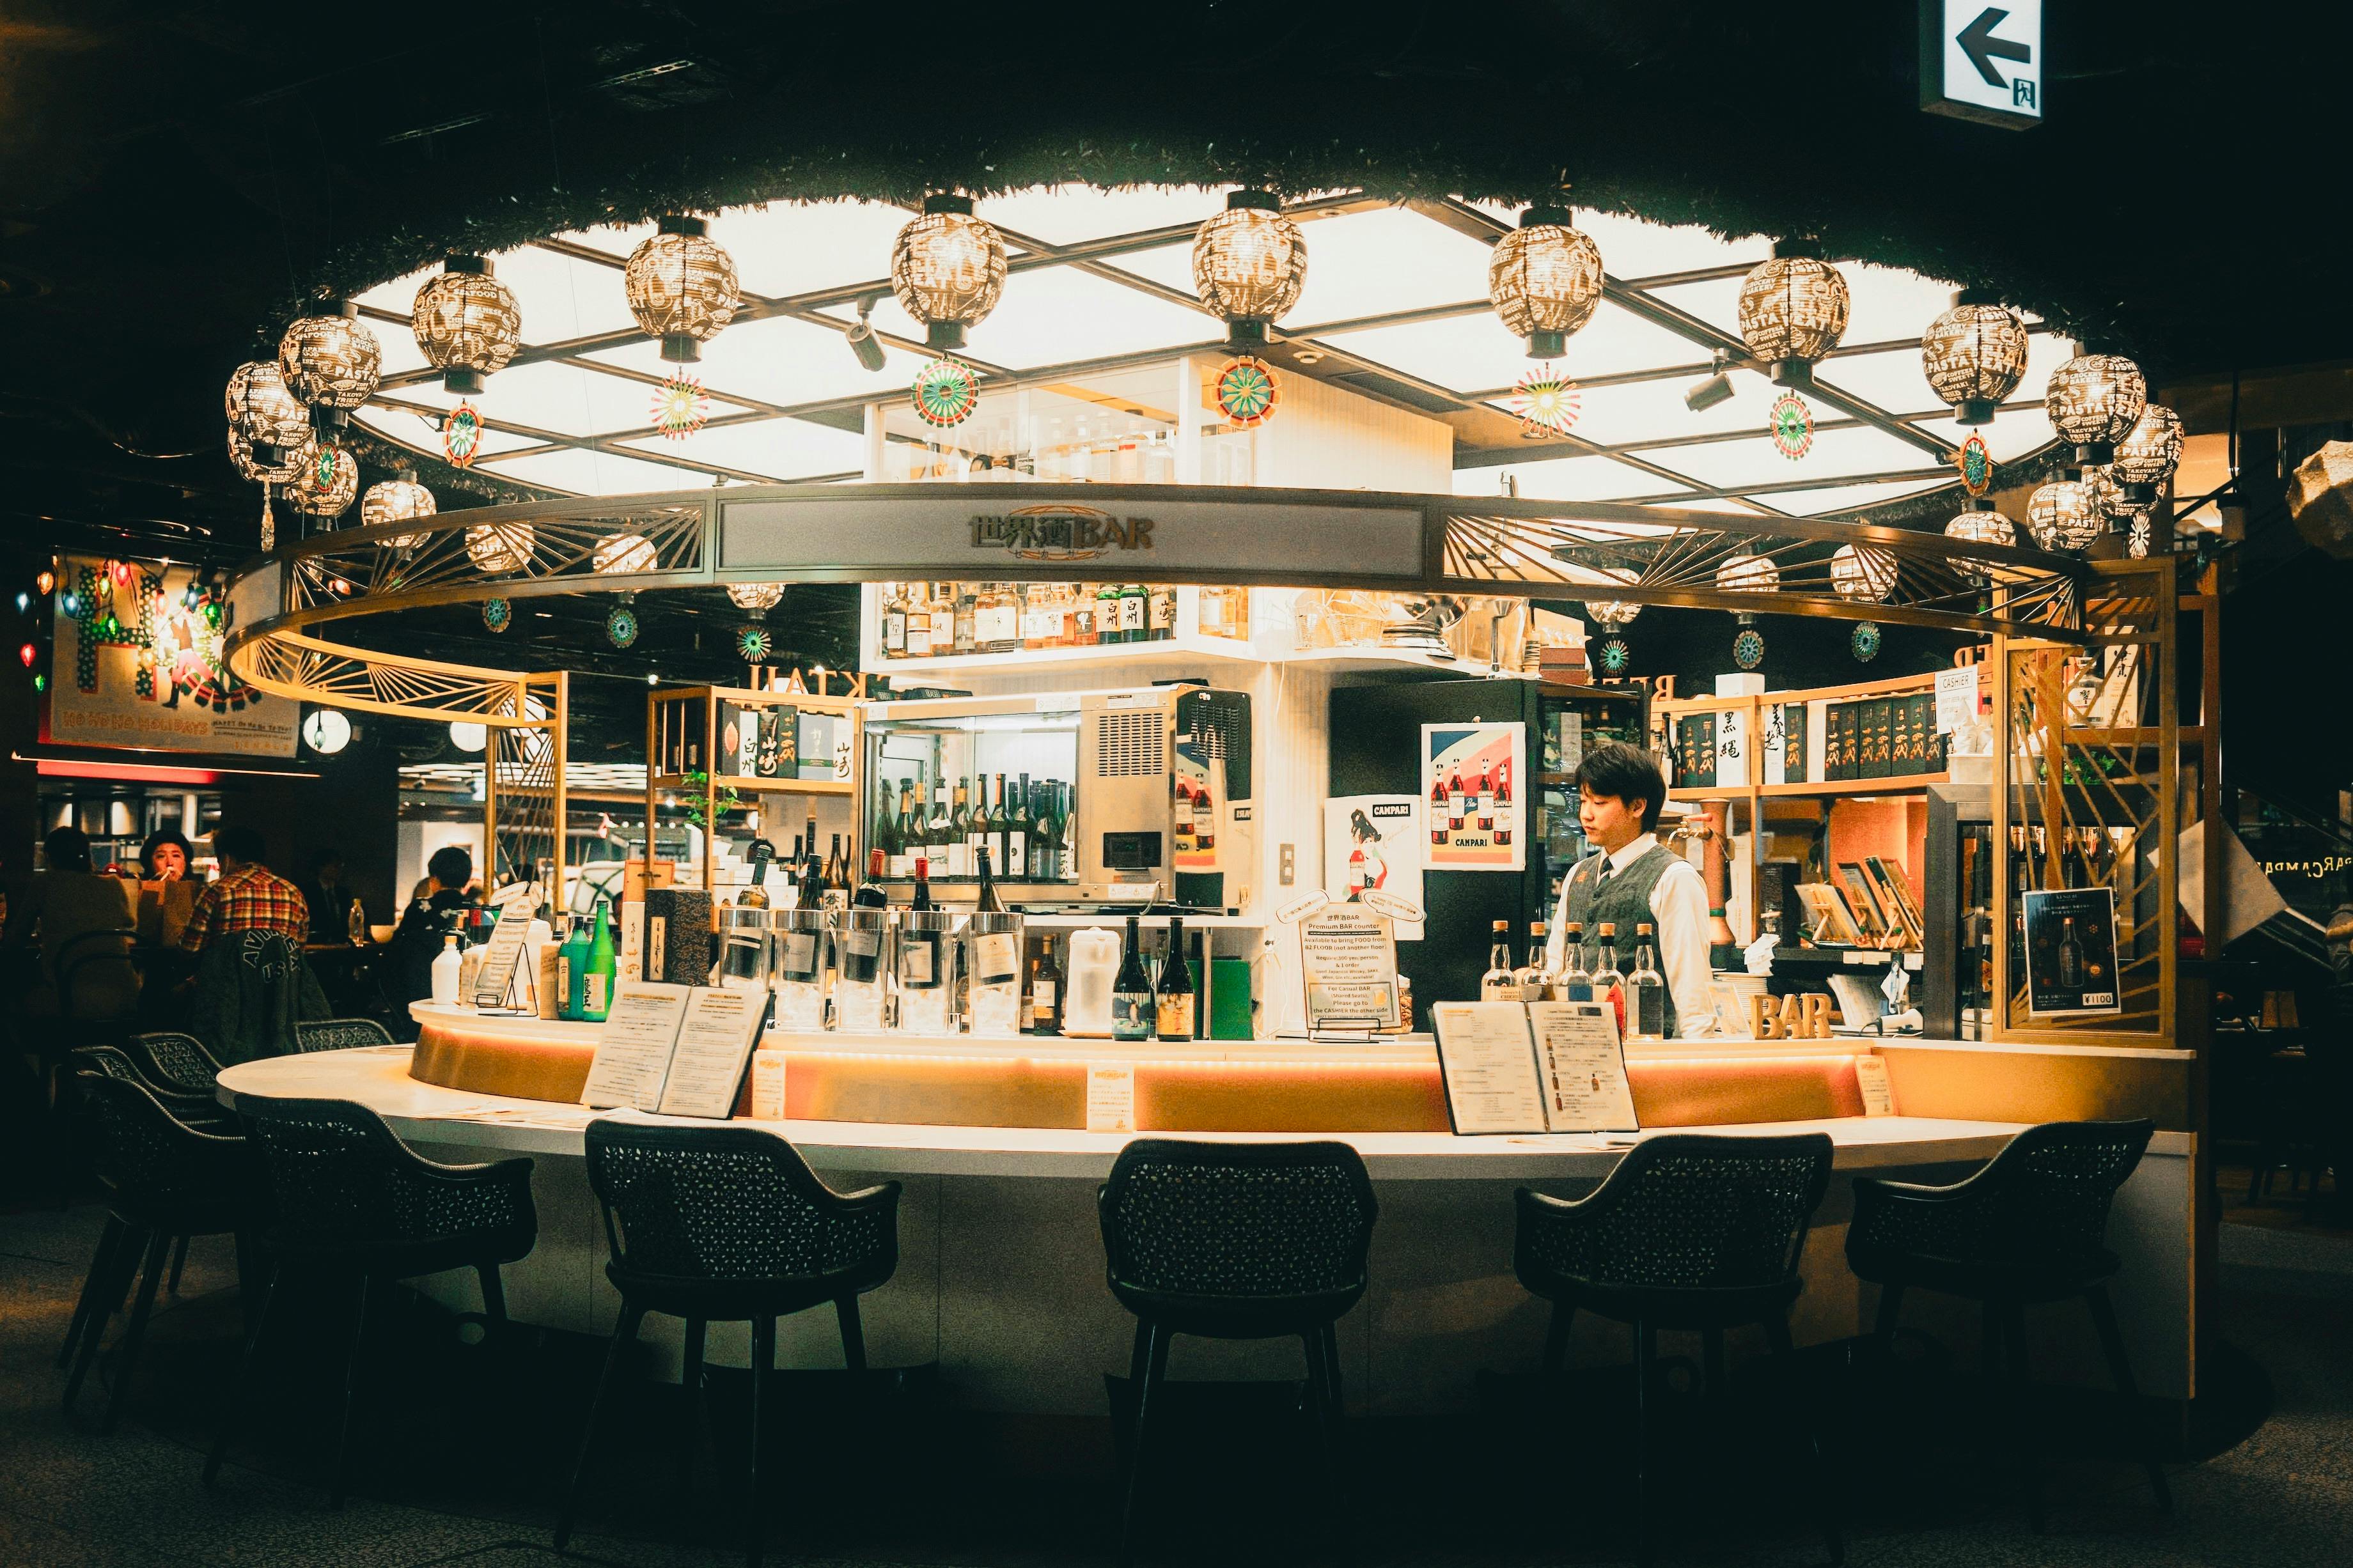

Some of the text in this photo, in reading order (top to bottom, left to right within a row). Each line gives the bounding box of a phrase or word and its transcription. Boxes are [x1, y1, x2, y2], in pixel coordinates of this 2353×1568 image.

[2059, 402, 2106, 415] PASTA
[2122, 447, 2166, 456] PASTA
[968, 515, 1153, 550] 世界酒BAR
[1107, 603, 1118, 626] 白州
[1127, 600, 1137, 625] 白州
[1943, 675, 1969, 688] CASHIER
[1373, 805, 1409, 816] CAMPARI
[2084, 995, 2112, 1004] ¥1100
[1749, 993, 1834, 1040] BAR
